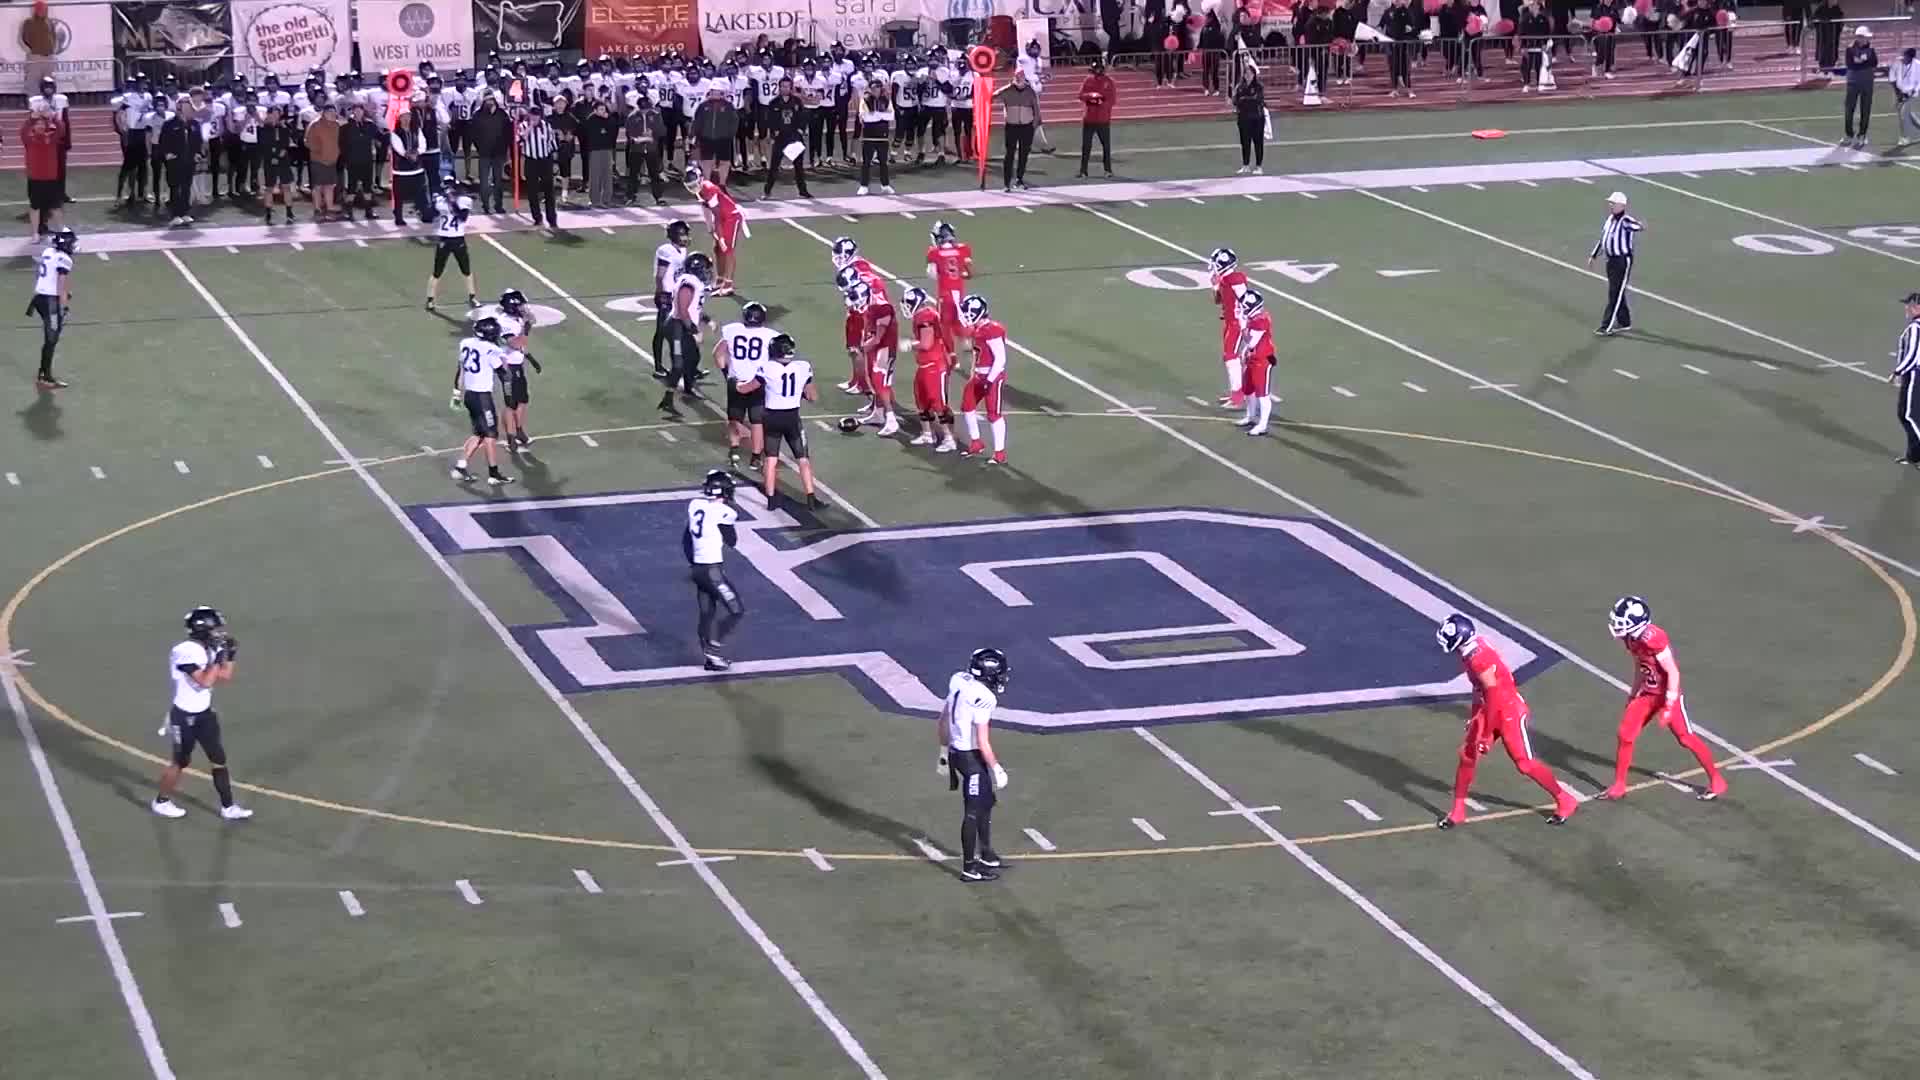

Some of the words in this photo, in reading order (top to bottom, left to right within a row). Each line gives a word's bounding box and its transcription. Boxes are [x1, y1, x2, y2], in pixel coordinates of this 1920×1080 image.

[256, 23, 280, 38] the
[284, 16, 308, 31] old
[258, 24, 330, 51] spaghetti
[261, 43, 318, 64] factory
[373, 44, 410, 60] WEST
[416, 43, 461, 58] HOMES
[600, 44, 629, 54] LAKE
[634, 42, 686, 54] OSWEGO
[763, 83, 777, 97] 82
[440, 215, 458, 232] 24
[733, 335, 763, 361] 68
[462, 346, 481, 374] 23
[781, 372, 796, 398] 11
[690, 509, 705, 539] 3
